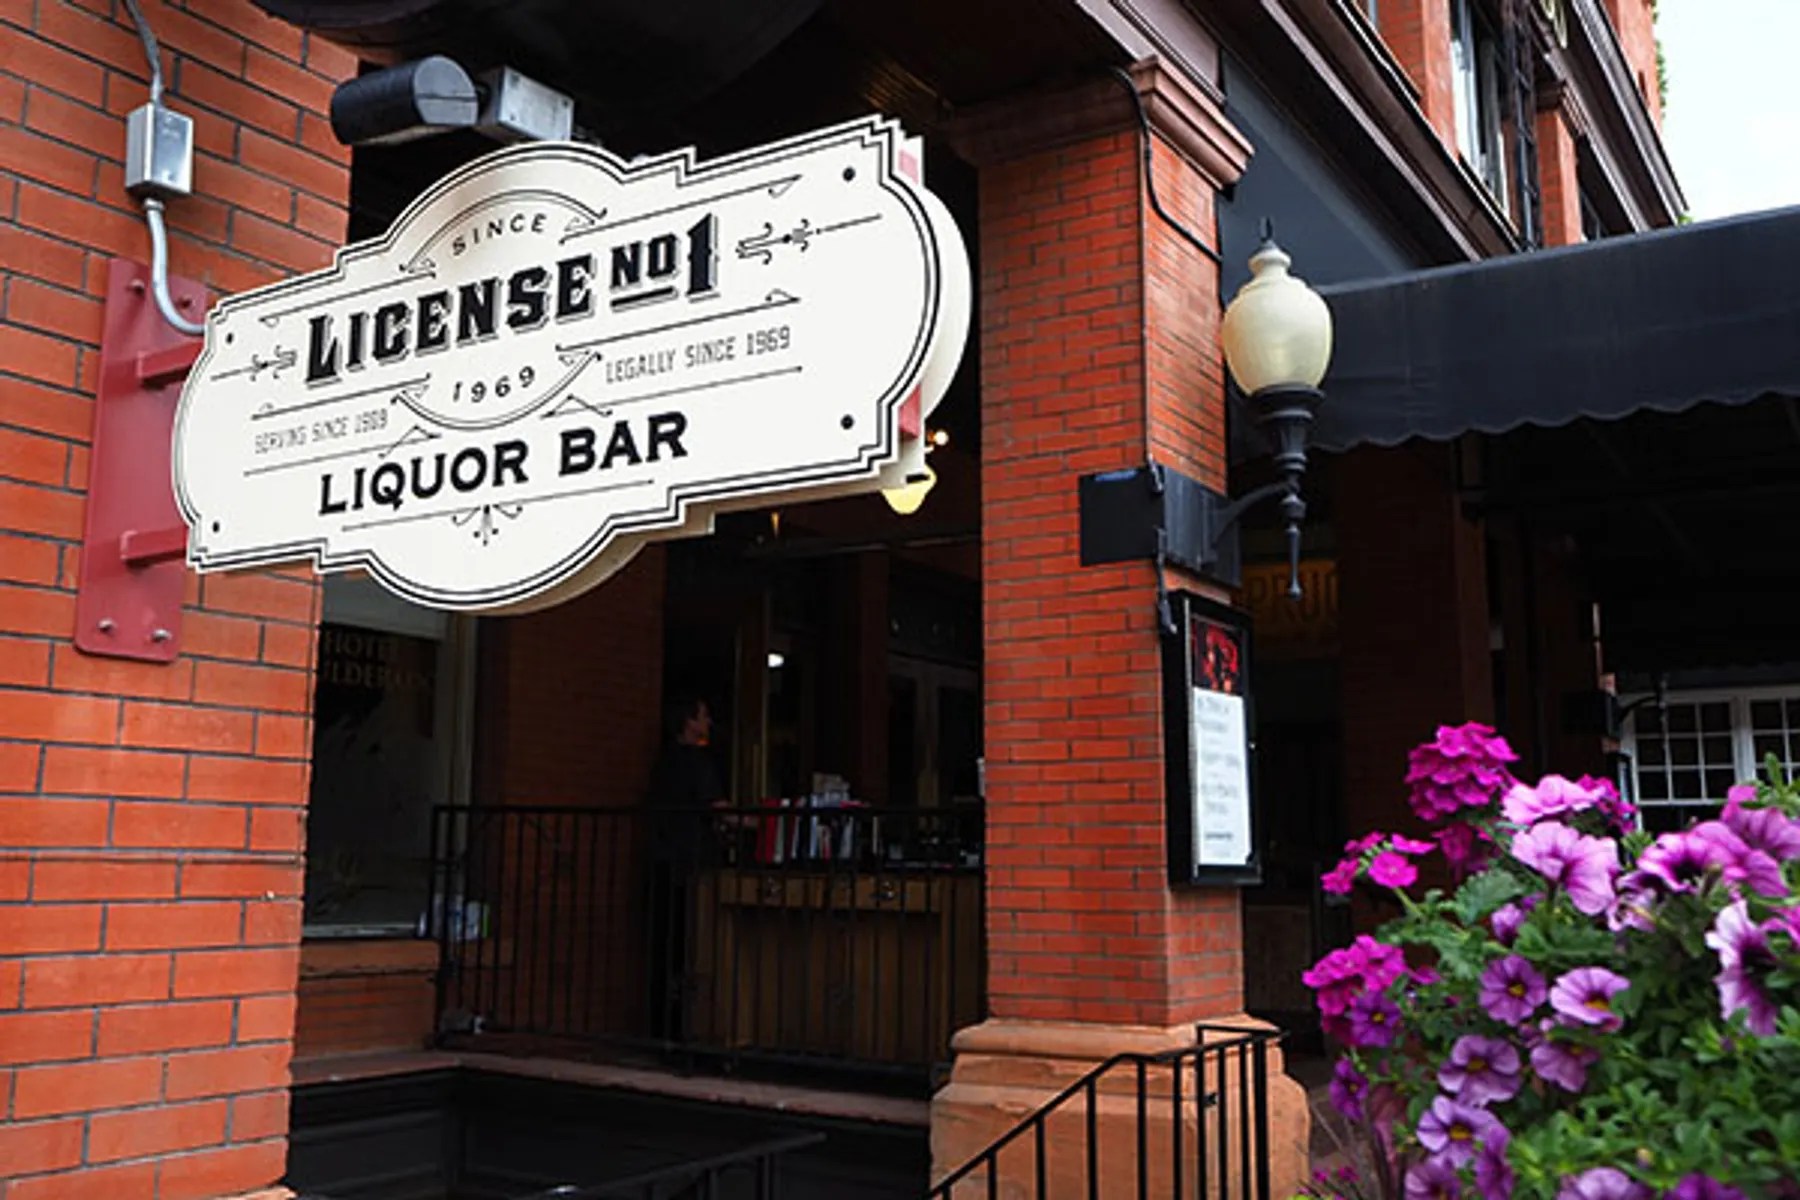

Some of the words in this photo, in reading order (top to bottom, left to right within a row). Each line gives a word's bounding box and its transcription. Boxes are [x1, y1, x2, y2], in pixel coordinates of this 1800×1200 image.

[452, 212, 548, 257] SINCE
[304, 253, 597, 390] LICENSE
[605, 349, 677, 384] LEGALLY
[684, 335, 736, 368] SINCE
[746, 324, 791, 356] 1969
[452, 365, 536, 404] 1969
[311, 415, 349, 443] SINCE
[318, 439, 530, 517] LIQUOR
[558, 410, 689, 477] BAR
